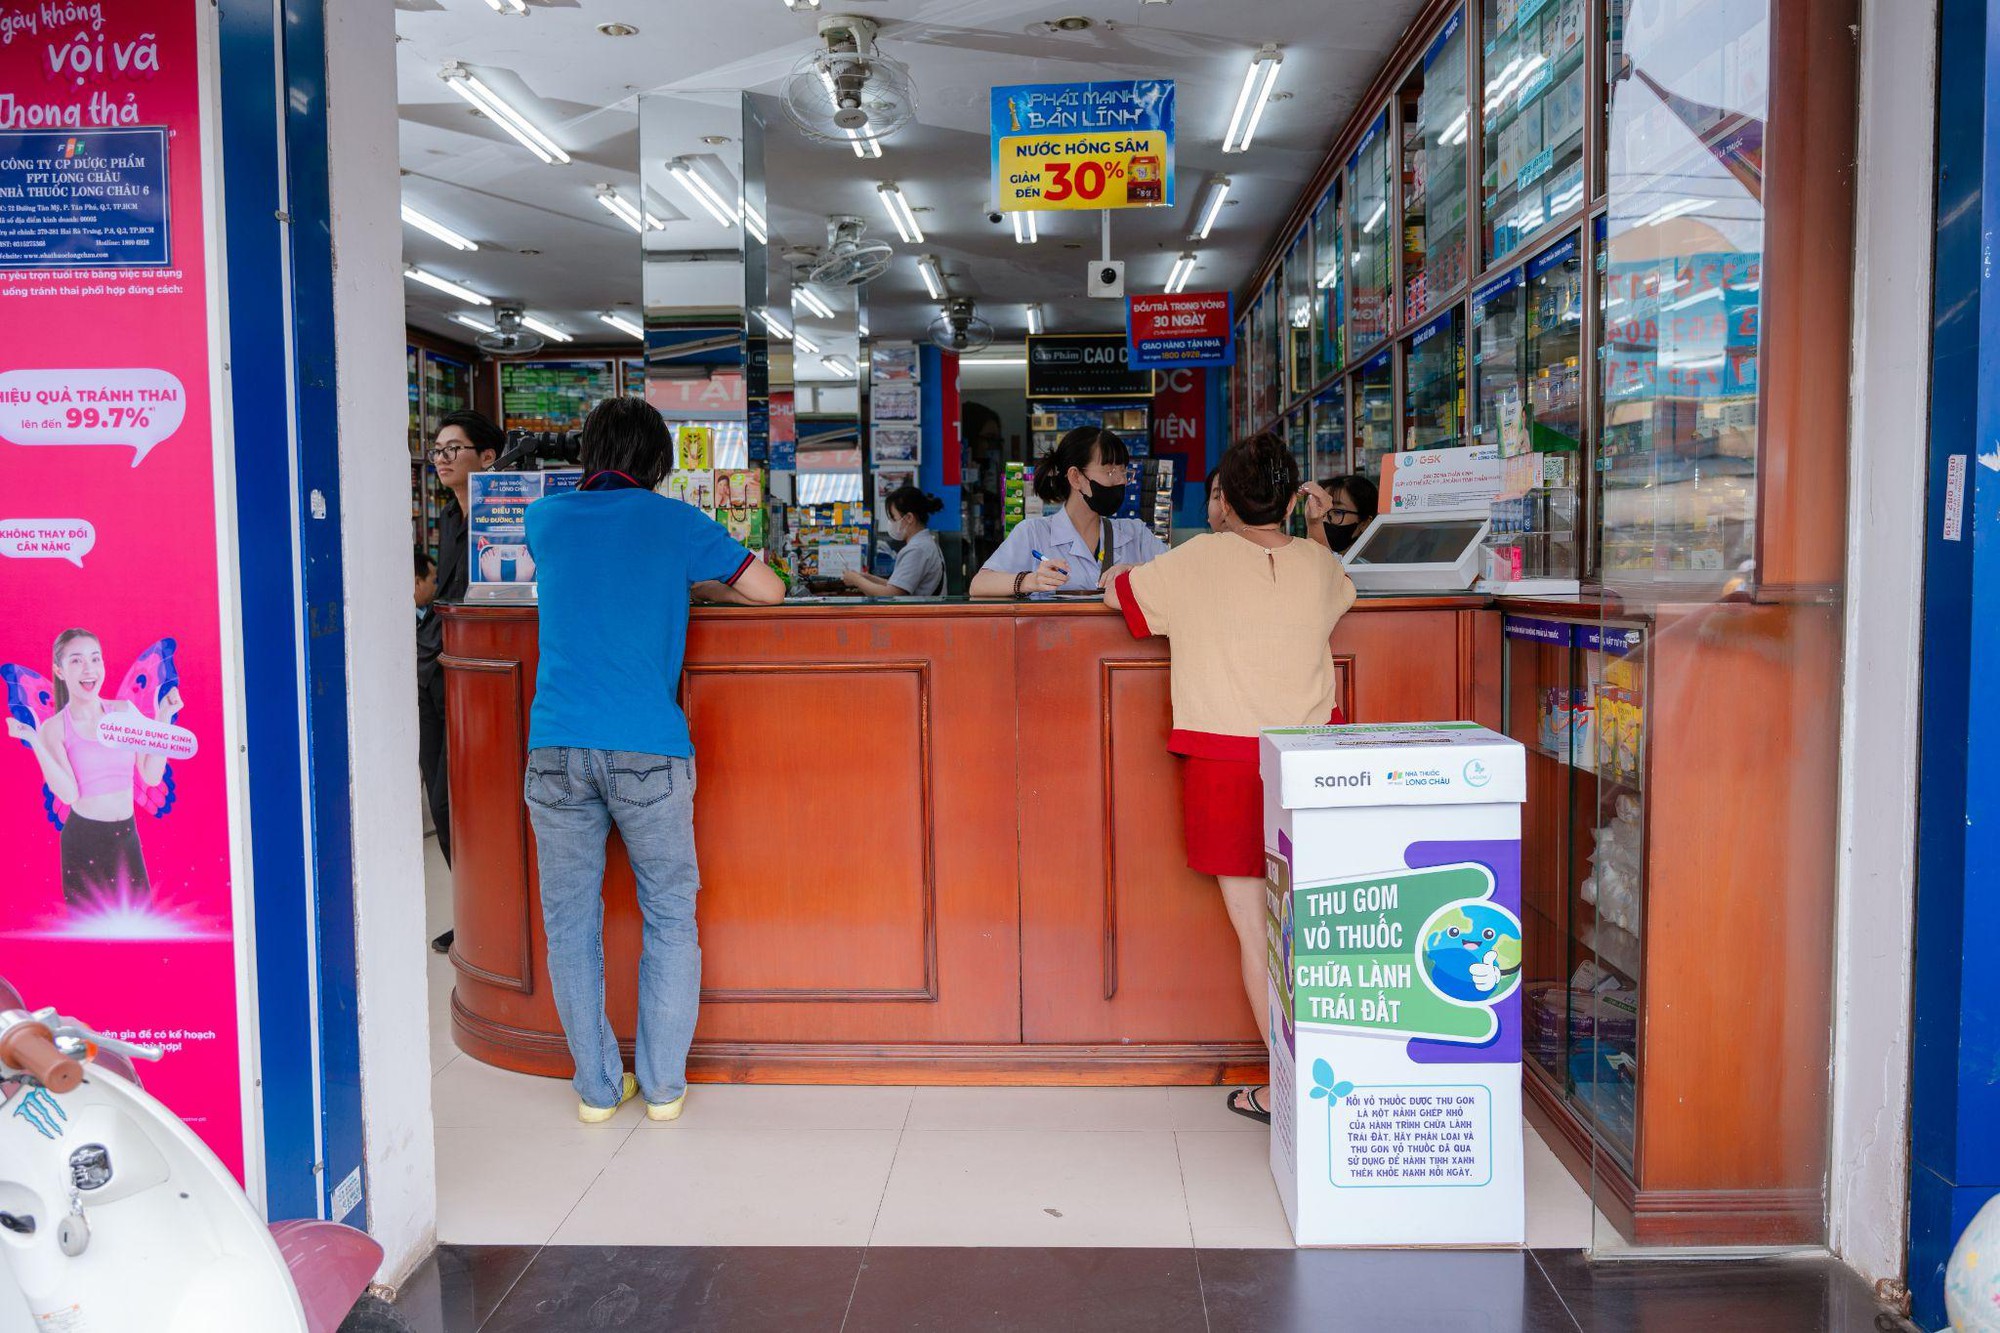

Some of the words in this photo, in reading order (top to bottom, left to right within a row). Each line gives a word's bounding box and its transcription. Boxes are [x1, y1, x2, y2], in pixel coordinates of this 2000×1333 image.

[0, 8, 37, 44] gày
[41, 1, 106, 31] không
[48, 31, 104, 86] vội
[113, 33, 160, 71] vã
[88, 91, 139, 127] thả
[1028, 106, 1077, 129] BẢN
[1082, 107, 1144, 127] LĨNH
[1016, 141, 1061, 157] NƯỚC
[1115, 138, 1149, 153] SÂM
[1, 157, 34, 170] CÔNG
[37, 160, 52, 169] TY
[55, 159, 71, 169] CP
[26, 173, 49, 184] FPT
[52, 173, 84, 183] LONG
[87, 171, 121, 182] CHÂU
[1010, 170, 1040, 184] GIẢM
[71, 186, 104, 196] LONG
[106, 183, 140, 195] CHÂU
[142, 186, 150, 195] 6
[1015, 185, 1041, 198] ĐẾN
[157, 269, 183, 280] dụng
[3, 285, 28, 297] uống
[30, 285, 57, 296] tránh
[60, 285, 79, 295] thai
[82, 285, 104, 297] phối
[107, 285, 126, 297] hợp
[128, 284, 154, 296] đúng
[1170, 302, 1200, 311] TRONG
[1201, 300, 1225, 310] VÒNG
[1153, 315, 1169, 327] 30
[1172, 311, 1206, 327] NGÀY
[1142, 341, 1162, 350] GIAO
[1163, 338, 1186, 349] HÀNG
[1204, 337, 1221, 348] NHÀ
[1084, 347, 1115, 363] CAO
[1162, 351, 1179, 359] 1800
[36, 386, 72, 405] QUẢ
[77, 386, 133, 402] TRÁNH
[138, 389, 177, 402] THAI
[21, 419, 38, 429] lên
[41, 418, 62, 429] đến
[1419, 454, 1442, 465] GSK
[38, 529, 65, 539] THAY
[17, 541, 38, 551] CÂN
[171, 734, 192, 744] KINH
[170, 743, 191, 753] KINH
[1315, 771, 1371, 788] sanofi
[1405, 778, 1427, 786] LONG
[1429, 776, 1450, 786] CHÂU
[1307, 890, 1347, 917] THU
[1353, 884, 1398, 913] GOM
[1304, 920, 1330, 949] VỎ
[1336, 913, 1402, 949] THUỐC
[1297, 961, 1352, 988] CHỮA
[1358, 960, 1411, 989] LÀNH
[1309, 993, 1355, 1020] TRÁI
[1361, 990, 1401, 1023] ĐẤT
[120, 1030, 136, 1040] gia
[154, 1029, 167, 1039] có
[184, 1030, 216, 1041] hoạch
[1436, 1096, 1453, 1105] THU
[1351, 1145, 1368, 1153] THU
[1454, 1144, 1471, 1153] QUA
[1452, 1156, 1475, 1165] XANH
